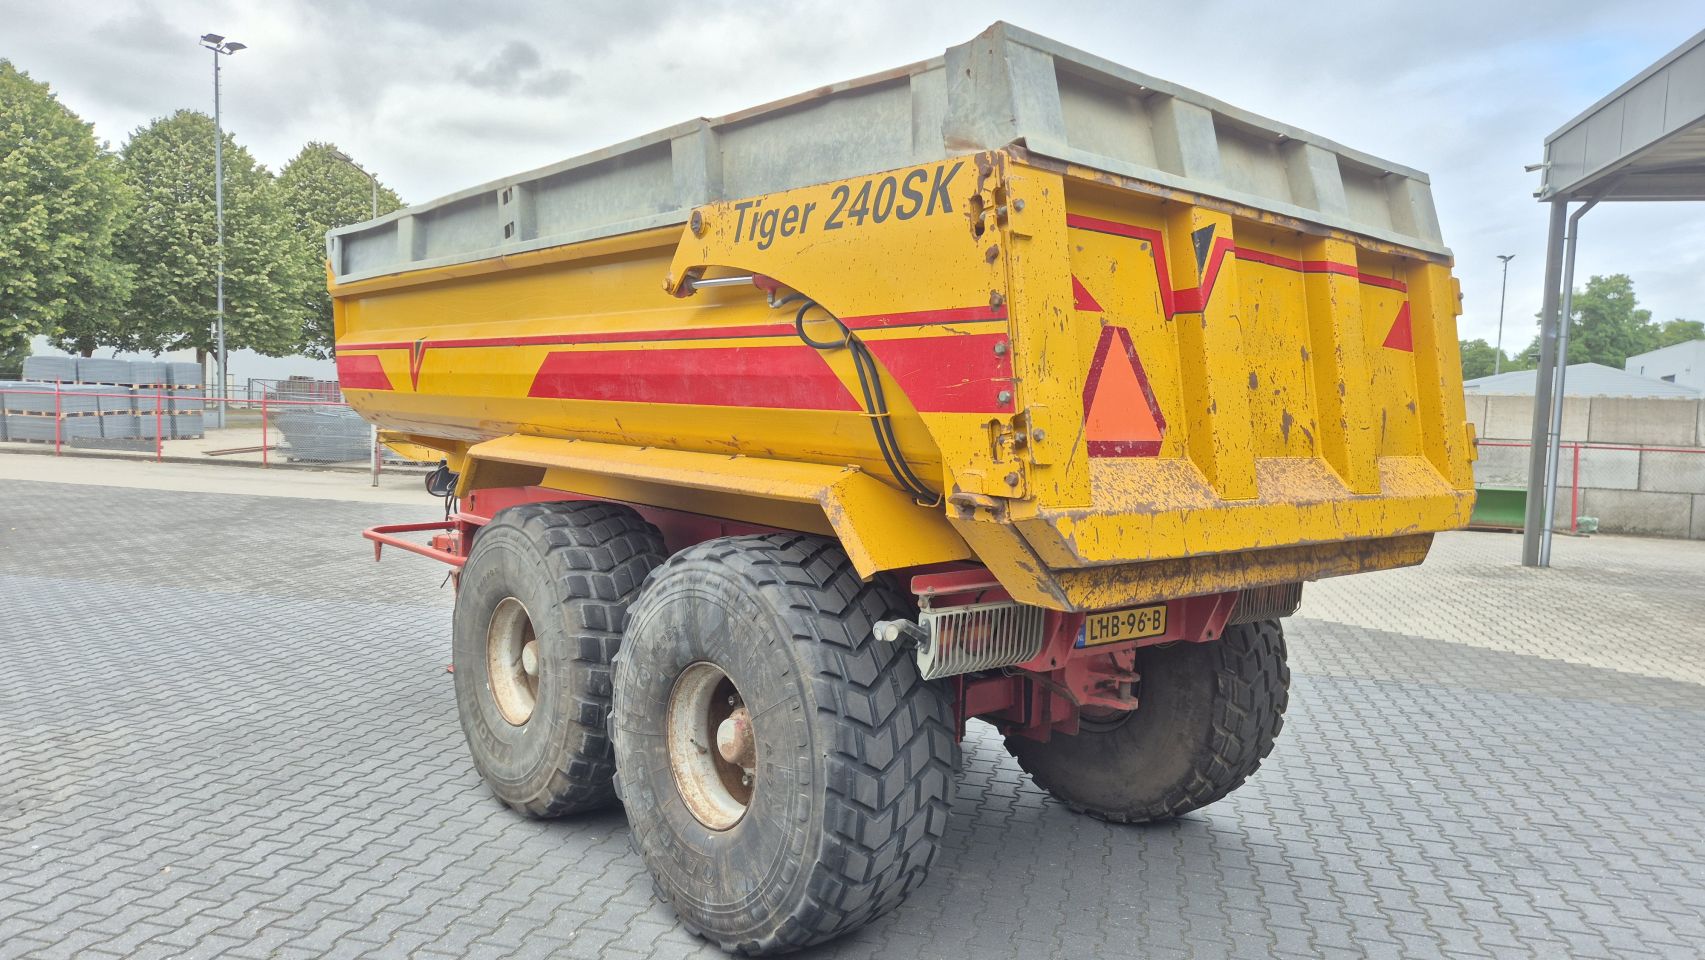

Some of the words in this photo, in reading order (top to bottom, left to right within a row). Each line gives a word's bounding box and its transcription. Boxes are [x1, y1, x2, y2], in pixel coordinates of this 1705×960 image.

[733, 199, 816, 250] Tiger
[823, 161, 965, 231] 240SK
[1090, 610, 1161, 640] LHB-96-B
